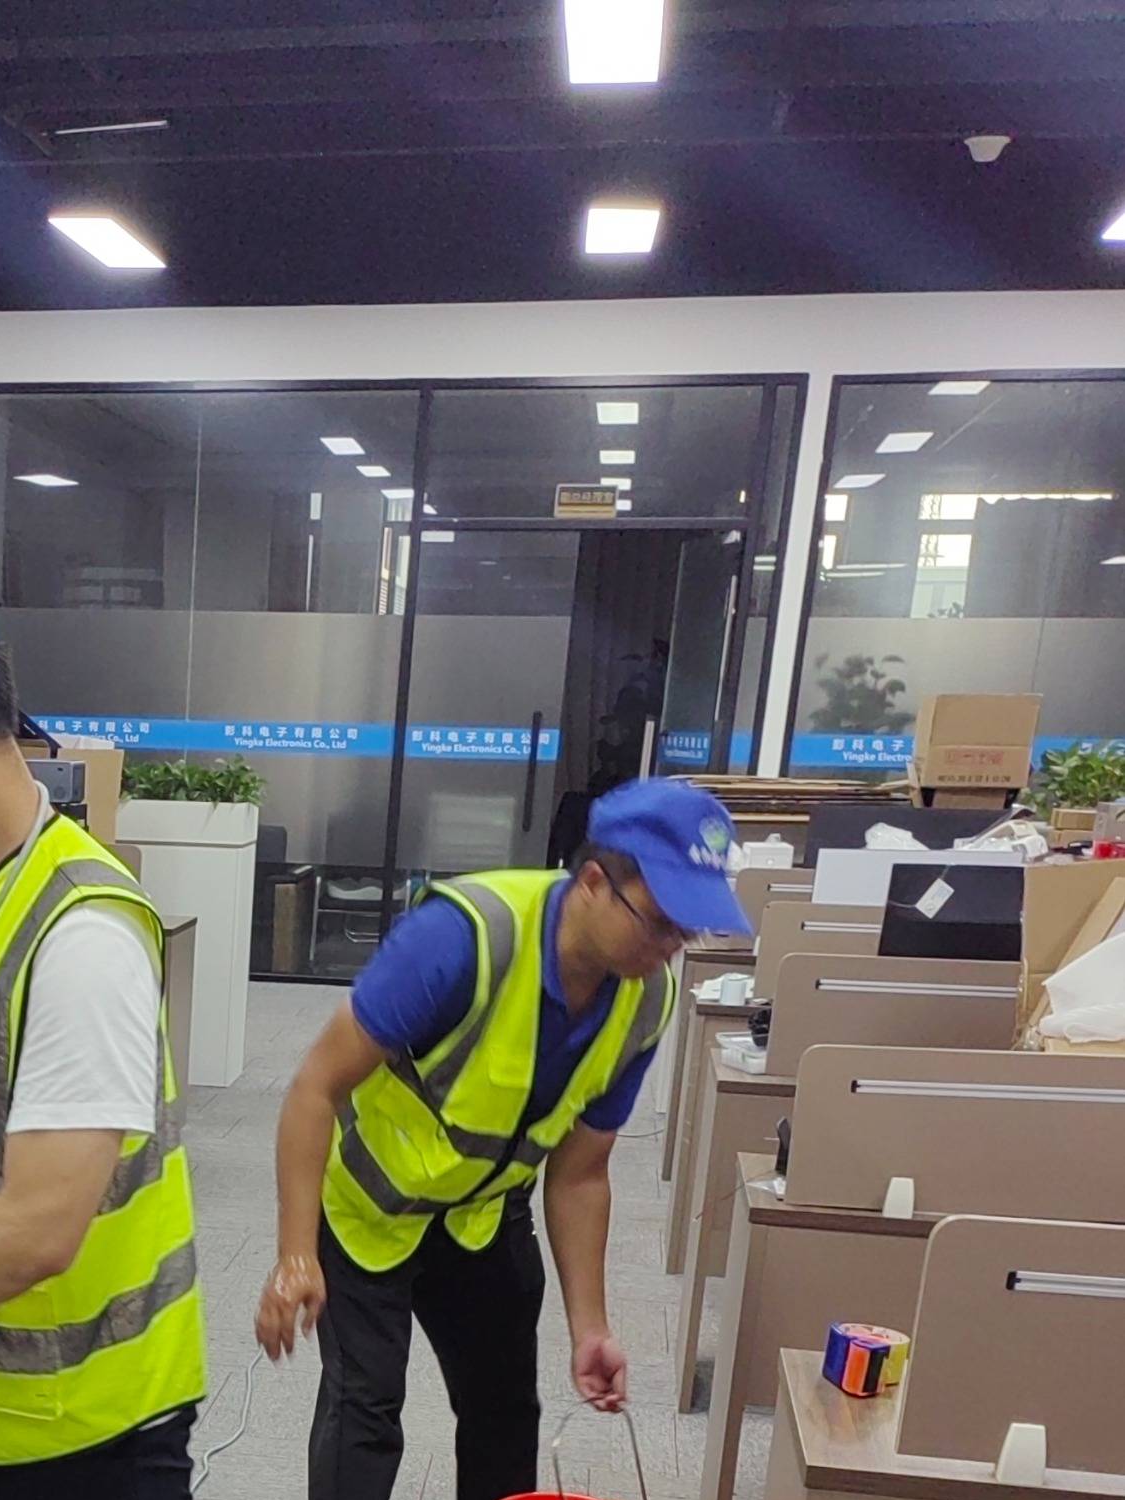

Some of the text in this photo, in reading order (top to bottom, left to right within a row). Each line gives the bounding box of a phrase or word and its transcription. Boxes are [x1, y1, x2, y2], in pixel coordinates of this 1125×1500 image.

[225, 725, 358, 740] 影科电子有限公司
[125, 734, 139, 743] Ltd
[235, 737, 264, 748] Yingke
[265, 738, 312, 748] Electronics
[332, 740, 347, 749] Ltd
[422, 743, 453, 754] Yingke
[454, 743, 503, 754] Electronics
[832, 739, 915, 752] 影科电子
[843, 752, 876, 763] Yingke
